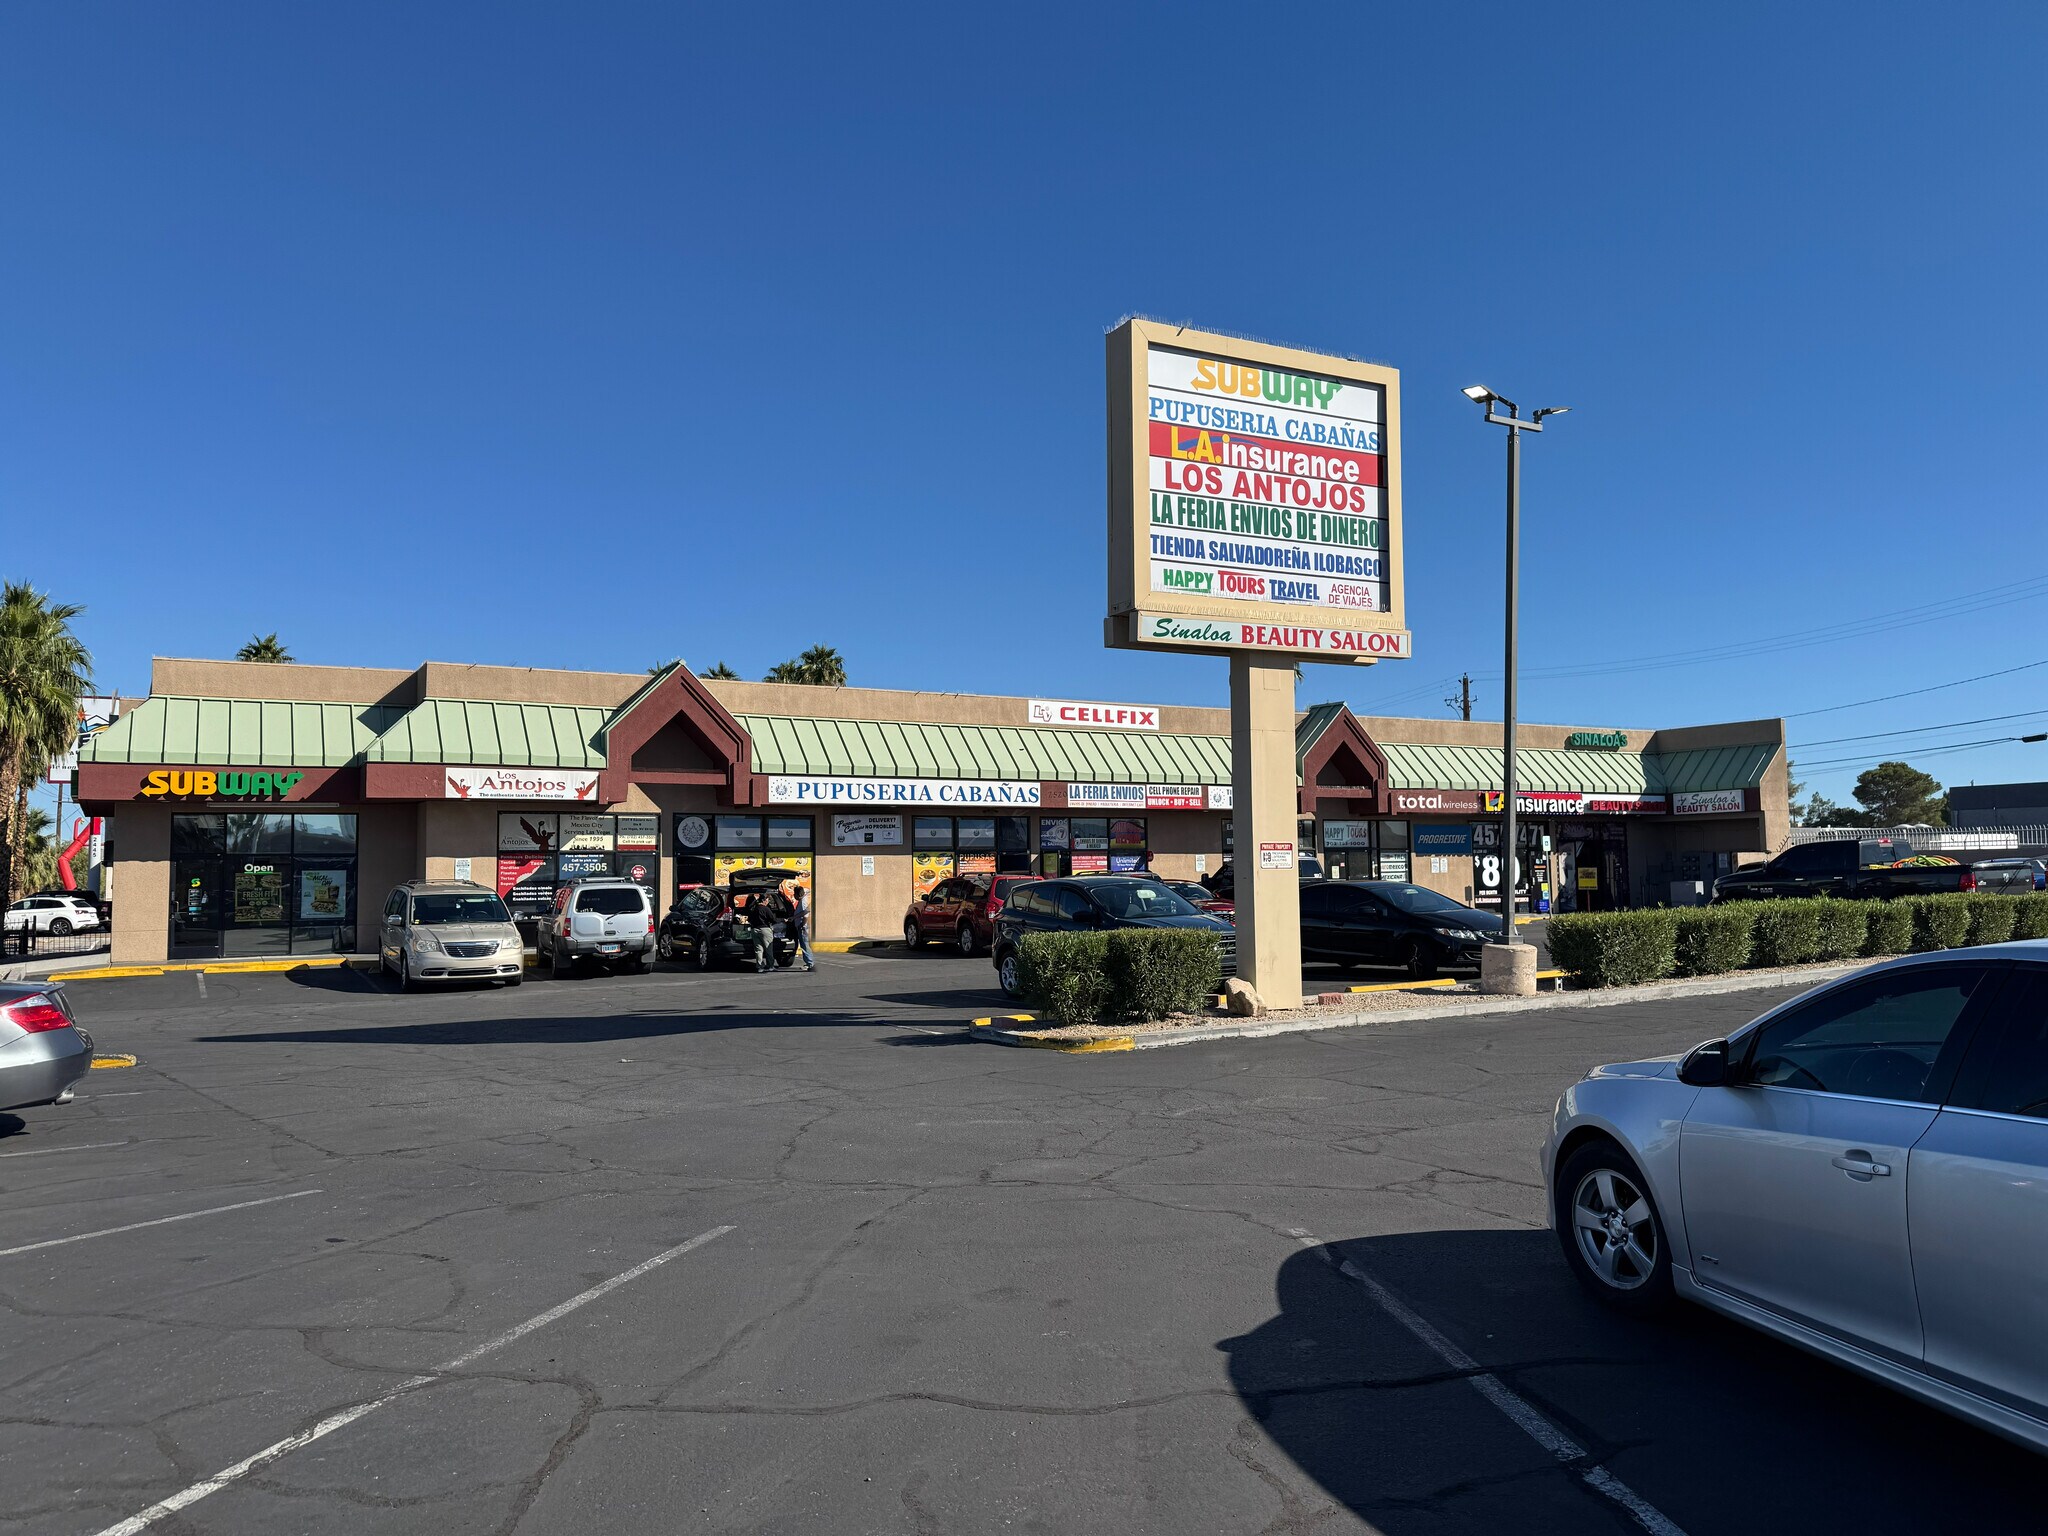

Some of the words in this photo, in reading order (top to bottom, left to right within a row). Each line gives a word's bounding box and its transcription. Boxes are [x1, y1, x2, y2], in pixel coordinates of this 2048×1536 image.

[1190, 359, 1344, 410] SUBWAY
[1149, 396, 1280, 437] PUPUSERIA
[1285, 419, 1381, 451] CABAÑAS
[1165, 460, 1223, 495] LOS
[1232, 470, 1366, 513] ANTOJOS
[1151, 492, 1174, 525] LA
[1177, 496, 1227, 531] FERIA
[1230, 502, 1293, 539] ENVIOS
[1296, 511, 1317, 541] DE
[1321, 513, 1380, 548] DINERO
[1150, 533, 1206, 560] TIENDA
[1208, 540, 1311, 571] SALVADOREÑA
[1314, 552, 1383, 578] ILOBASCO
[1163, 568, 1214, 592] HAPPY
[1217, 569, 1265, 596] TOURS
[1268, 579, 1320, 601] TRAVEL
[1330, 583, 1371, 598] AGENCIA
[1328, 593, 1341, 605] DE
[1342, 595, 1373, 608] VIAJES
[1152, 617, 1233, 642] Sinaloa
[1241, 624, 1324, 649] BEAUTY
[1330, 630, 1401, 654] SALON
[1060, 706, 1155, 726] CELLFIX
[496, 770, 518, 780] Los
[140, 770, 305, 797] SUBWAY
[478, 776, 567, 794] Antojos
[795, 781, 934, 801] PUPUSERIA
[939, 783, 1040, 803] CABAÑAS
[1069, 784, 1081, 800] LA
[1082, 785, 1109, 801] FERIA
[1110, 786, 1145, 801] ENVIOS
[1148, 786, 1161, 796] CELL
[1162, 786, 1179, 796] PHONE
[1180, 786, 1200, 797] REPAIR
[1147, 796, 1171, 806] UNLOCK
[1173, 797, 1185, 806] BUY
[1188, 798, 1202, 807] SELL
[1398, 794, 1442, 809] total
[1442, 801, 1478, 809] wireless
[1592, 800, 1633, 811] BEAUTY
[1676, 803, 1709, 813] BEAUTY
[1710, 802, 1740, 812] SALON
[1041, 818, 1068, 826] ENVIOS
[595, 829, 611, 837] Vegas
[1325, 827, 1345, 841] HAPPY
[1346, 824, 1367, 838] TOURS
[501, 839, 529, 847] Antojos
[1418, 834, 1467, 844] PROGRESSIVE
[959, 853, 996, 861] PUPUSAS
[243, 863, 274, 873] Open
[561, 862, 608, 872] 457-3505
